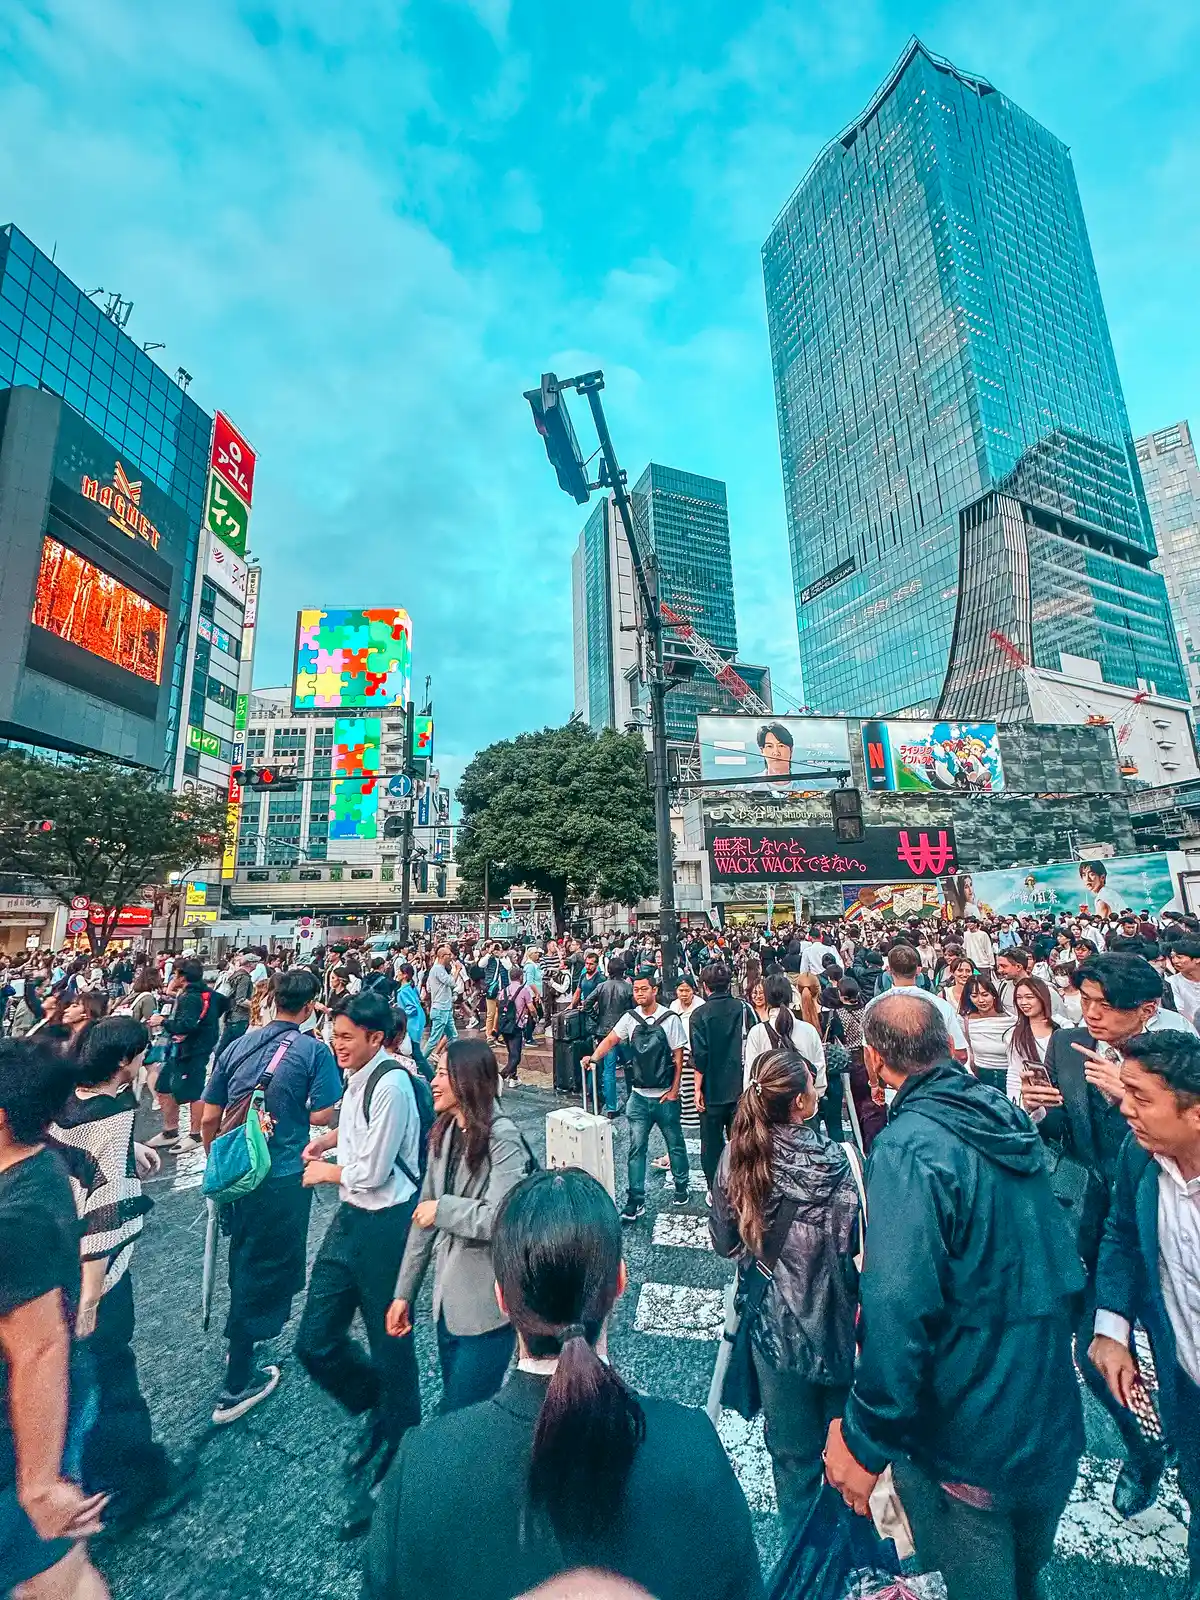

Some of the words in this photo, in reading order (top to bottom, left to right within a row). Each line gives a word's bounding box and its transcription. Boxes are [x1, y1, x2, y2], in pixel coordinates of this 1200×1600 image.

[82, 475, 161, 551] MAGNET
[212, 481, 241, 538] レイク
[237, 698, 245, 715] レイク
[192, 730, 217, 750] レイク
[900, 745, 934, 755] ライジング
[868, 743, 884, 768] N
[709, 805, 735, 820] JR
[738, 805, 783, 820] 渋谷駅
[713, 836, 806, 856] 無茶しないと、
[714, 857, 759, 874] WACK
[760, 854, 867, 873] WACKできない。
